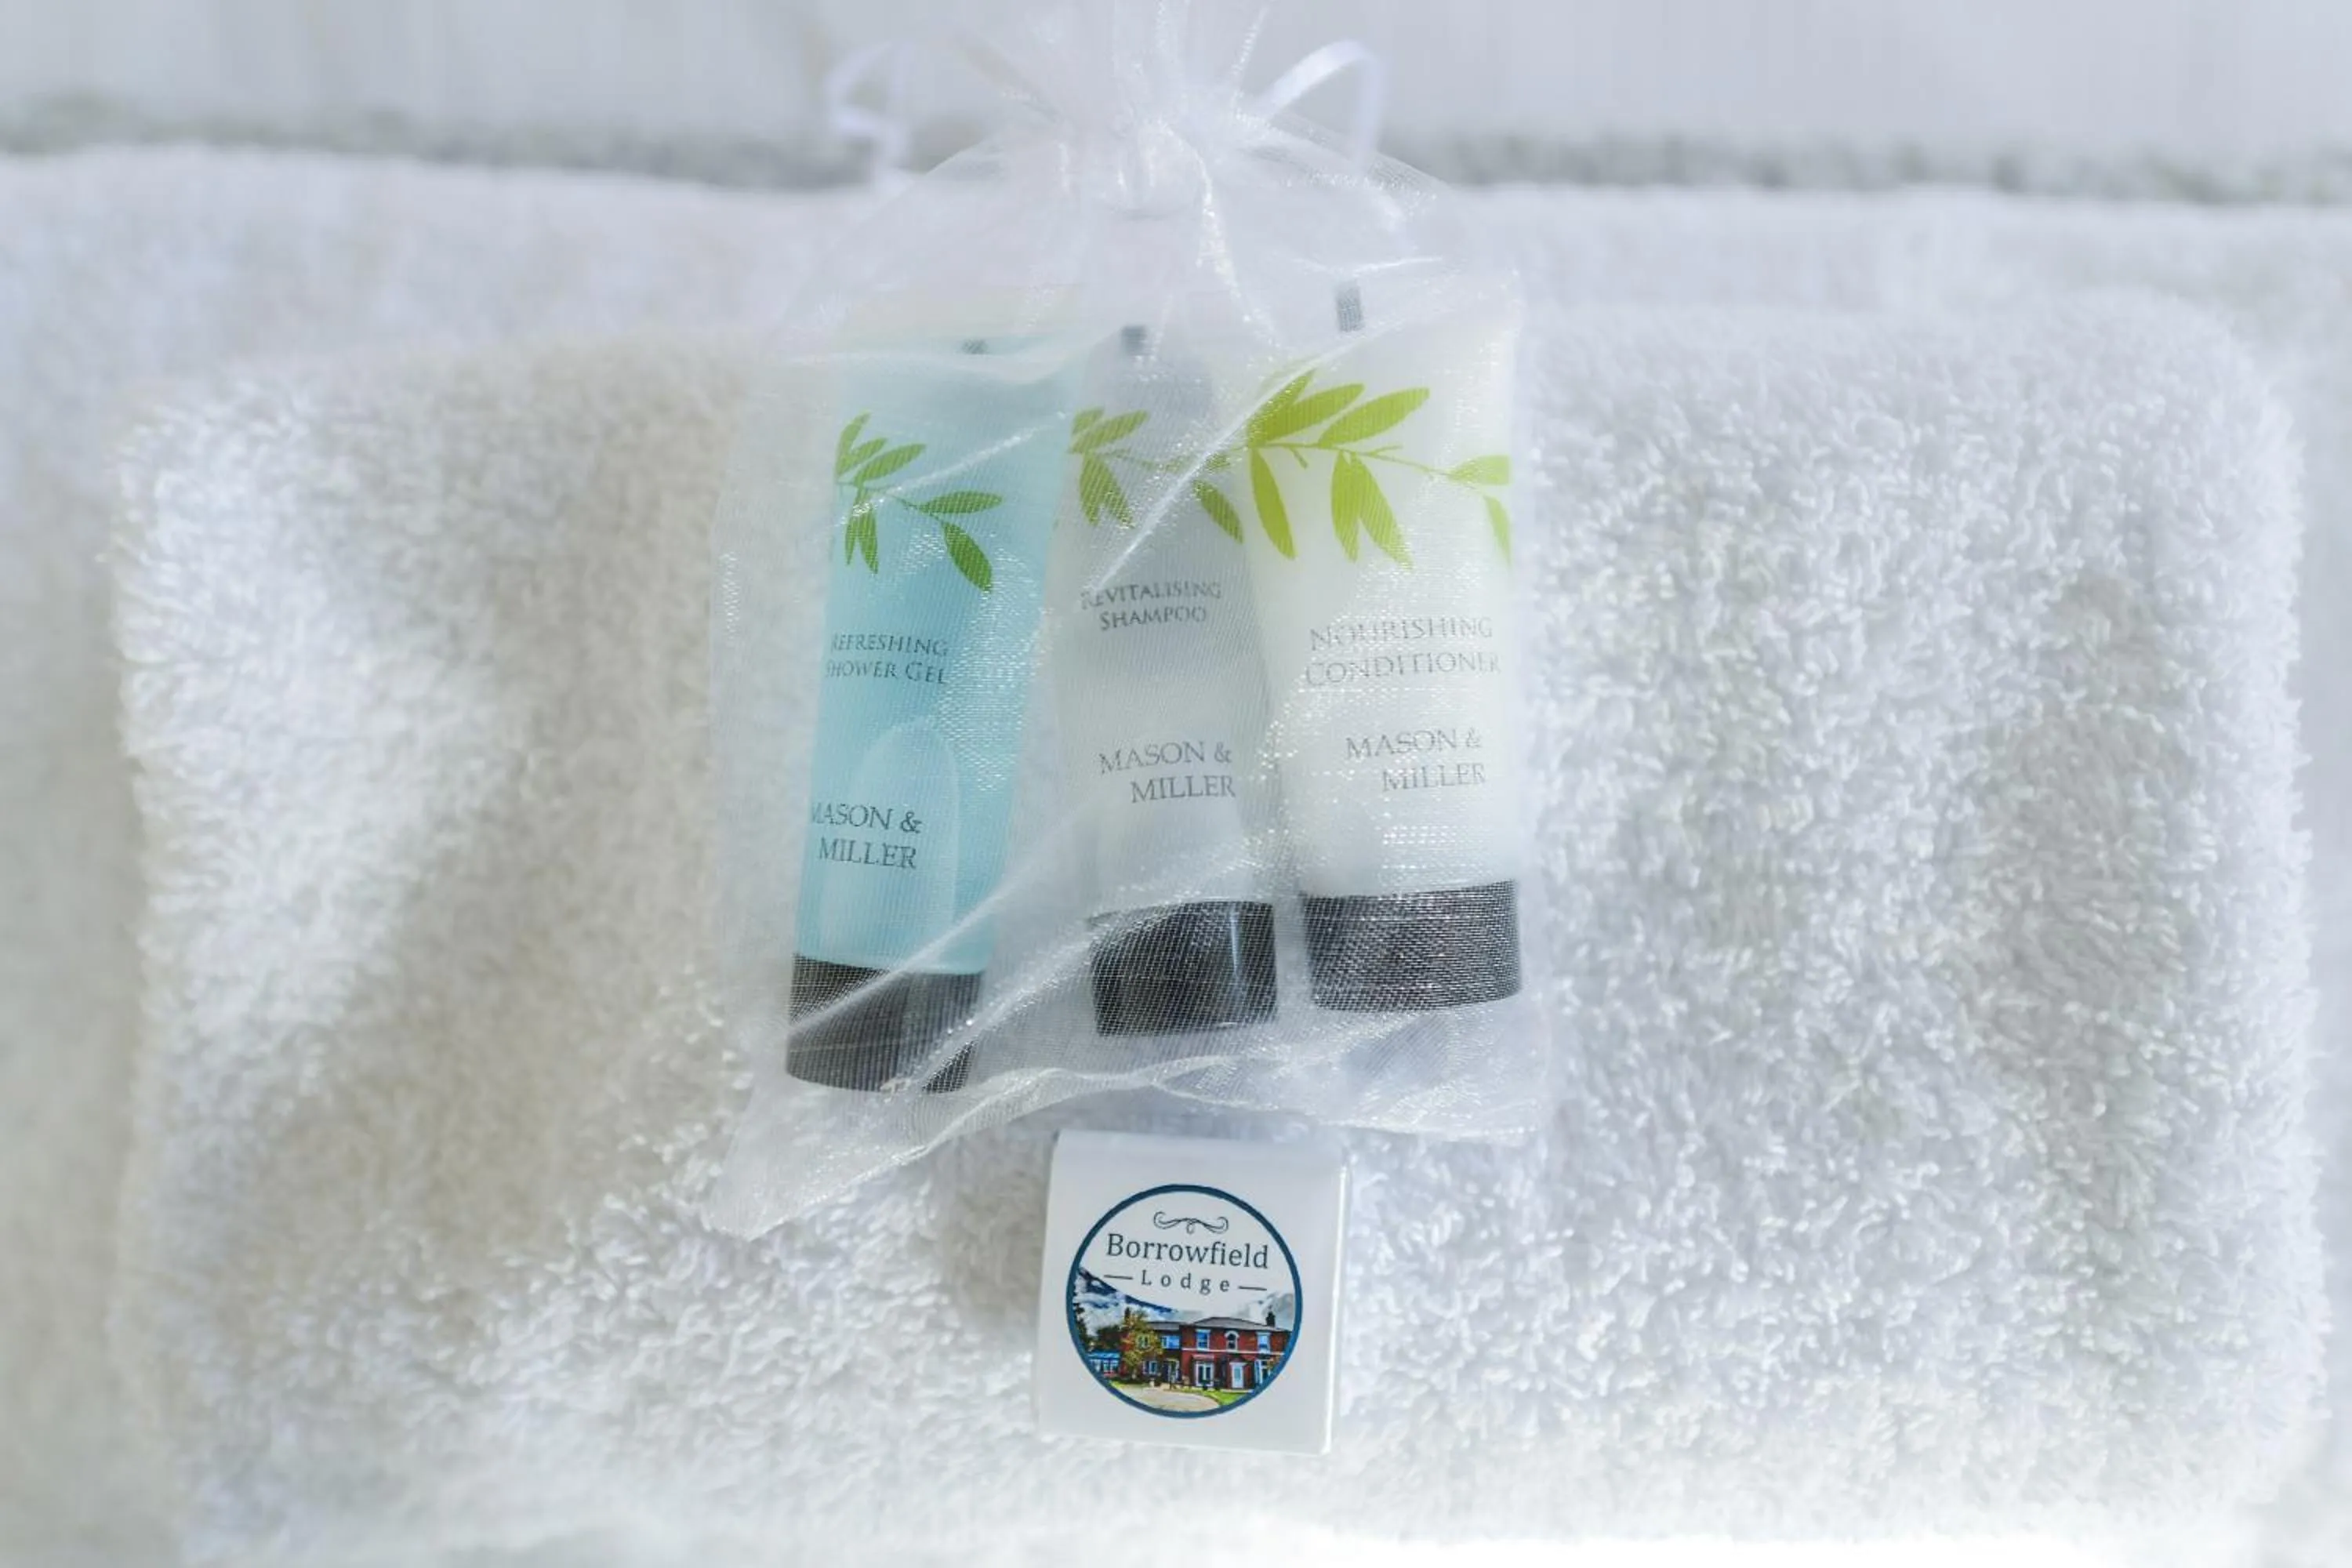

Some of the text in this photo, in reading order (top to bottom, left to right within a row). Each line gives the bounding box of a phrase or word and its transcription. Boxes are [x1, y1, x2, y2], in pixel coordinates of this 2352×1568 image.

[1100, 605, 1207, 631] SHAMPOO
[1310, 617, 1493, 652] NOURISHING
[905, 660, 946, 684] GEL
[1098, 741, 1232, 775] MASON &
[1345, 727, 1481, 759] MASON &
[1130, 775, 1236, 804] MILLER
[1382, 762, 1486, 792] MILLER
[901, 811, 922, 833] &
[819, 837, 917, 869] MILLER
[1105, 1233, 1269, 1269] Borrowfield
[1141, 1269, 1230, 1294] Lodge
